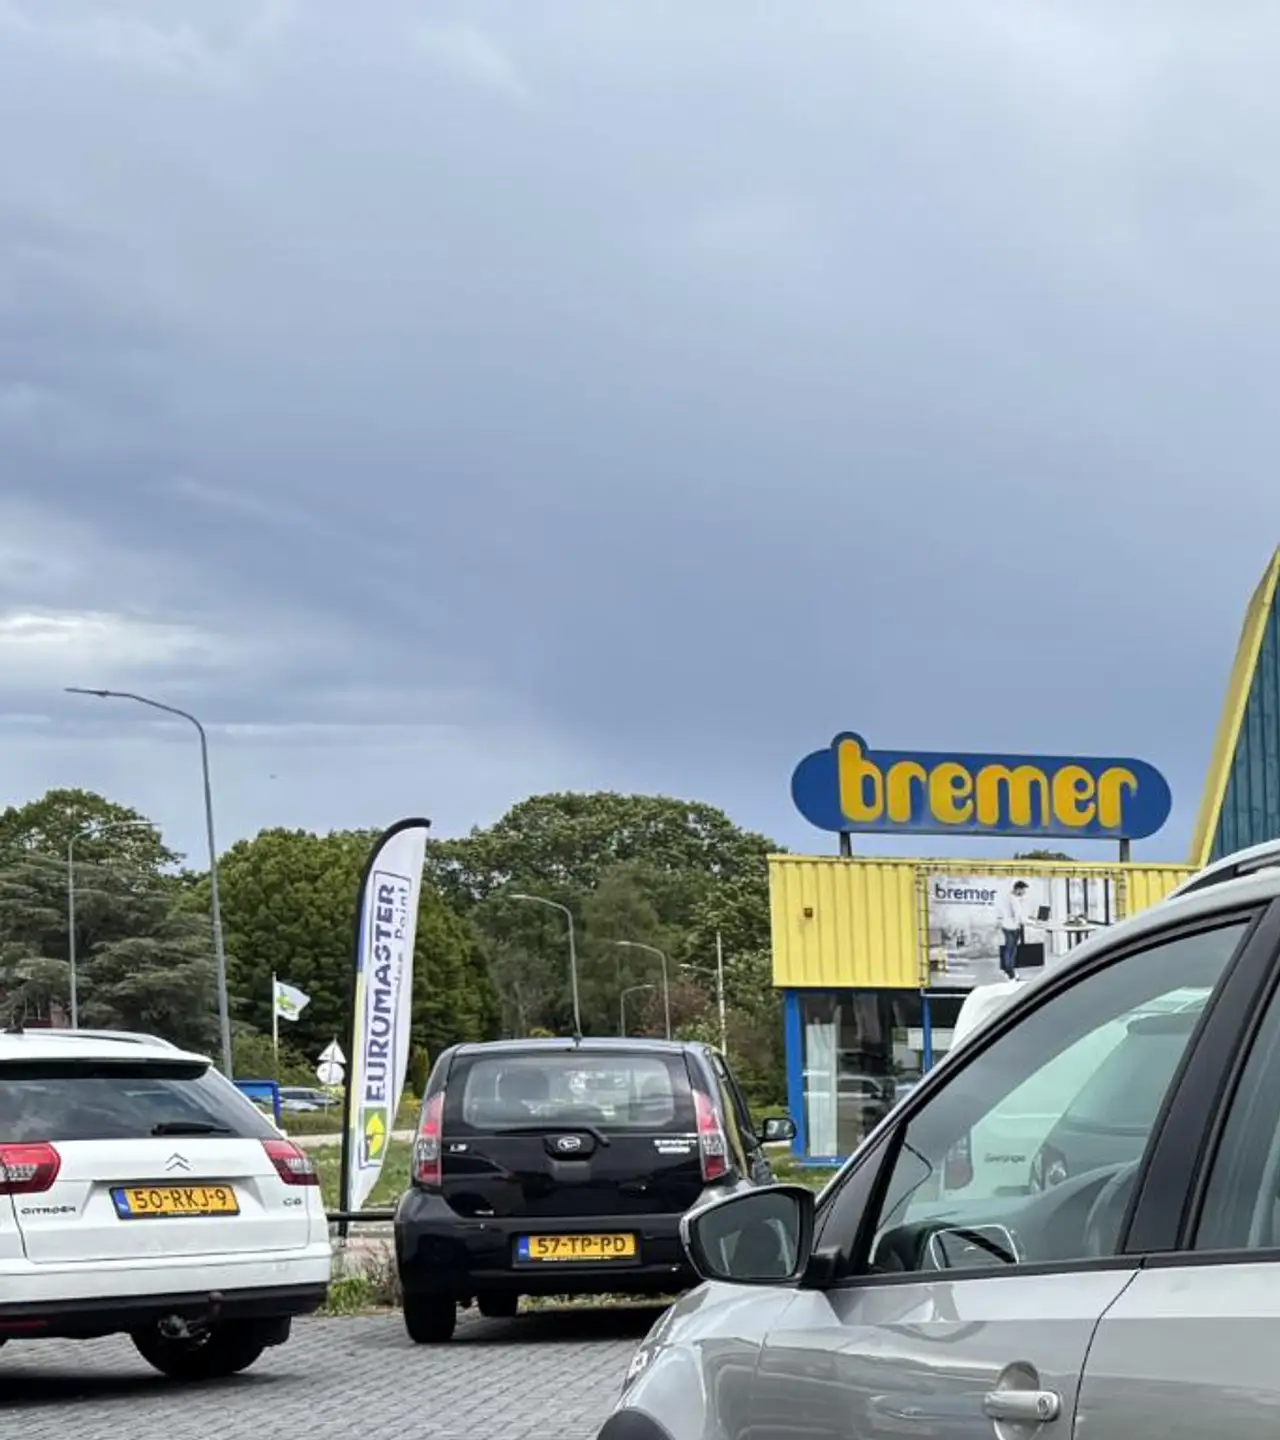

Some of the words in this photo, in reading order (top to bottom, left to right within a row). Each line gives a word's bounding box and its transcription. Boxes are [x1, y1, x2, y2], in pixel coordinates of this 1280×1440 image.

[837, 739, 1138, 828] bremer
[935, 883, 998, 901] bremer
[366, 883, 396, 1101] EUROMASTER
[134, 1188, 227, 1209] 50-RKJ-9
[537, 1236, 626, 1254] 57-TP-PD
